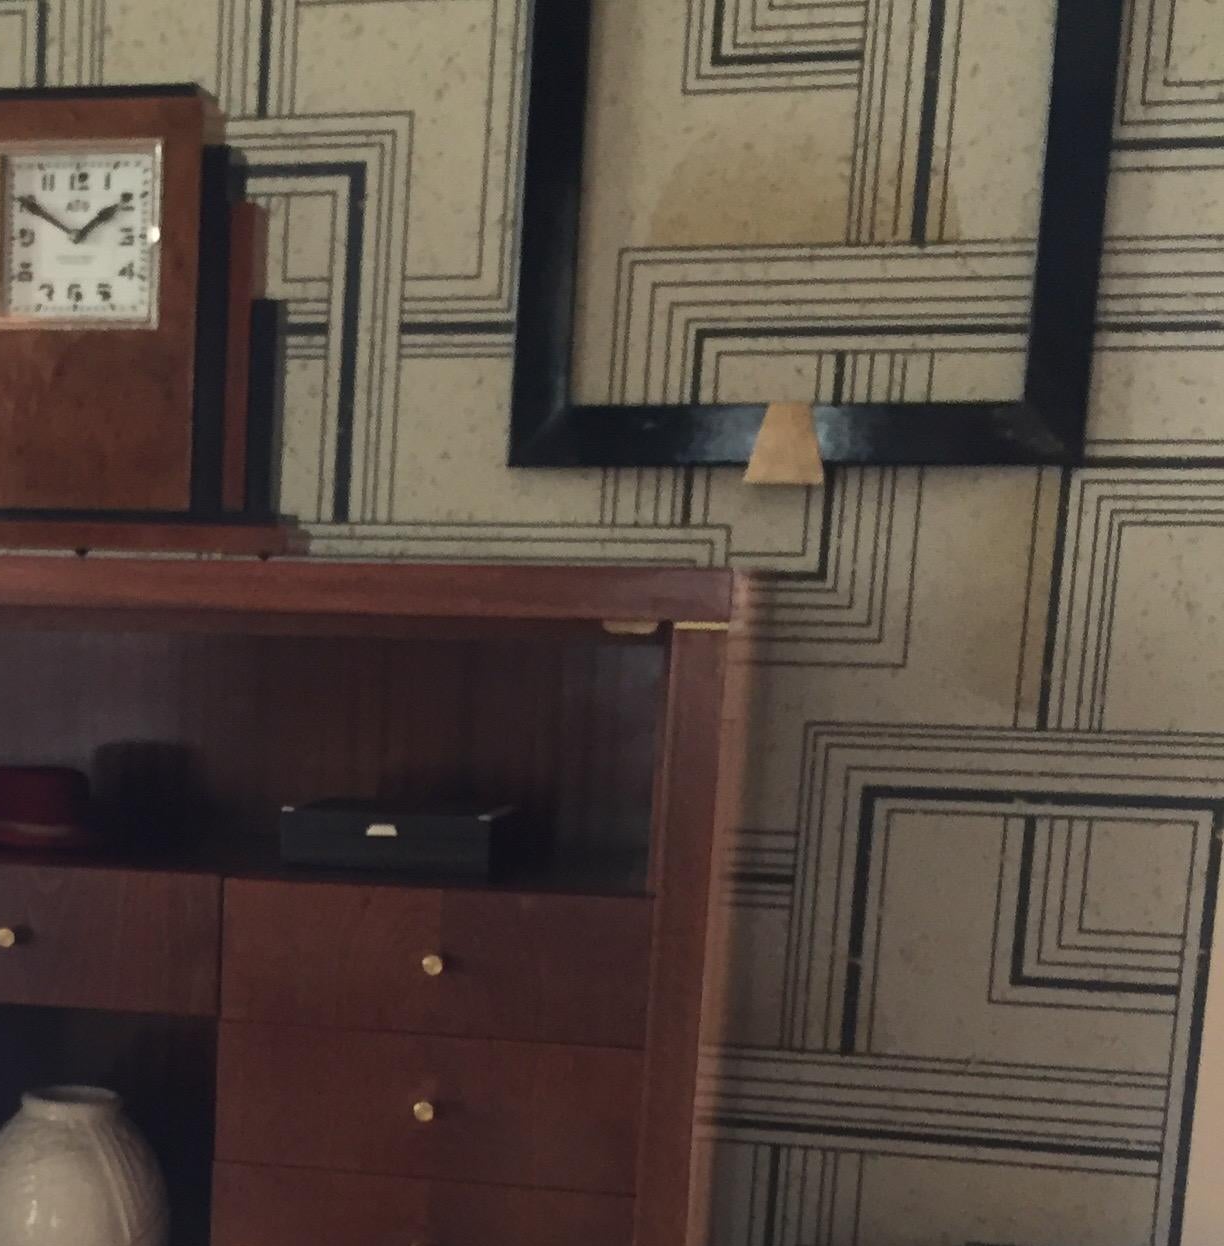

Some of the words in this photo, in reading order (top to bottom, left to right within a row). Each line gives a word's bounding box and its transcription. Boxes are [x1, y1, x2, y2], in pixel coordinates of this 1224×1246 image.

[42, 173, 55, 191] 11
[69, 172, 89, 191] 12
[104, 172, 112, 190] 1
[120, 192, 134, 211] 2
[19, 228, 35, 247] 9
[119, 227, 135, 246] 3
[18, 262, 33, 282] 8
[118, 262, 134, 280] 4
[39, 283, 54, 301] 7
[68, 284, 83, 301] 6
[97, 283, 112, 301] 5
